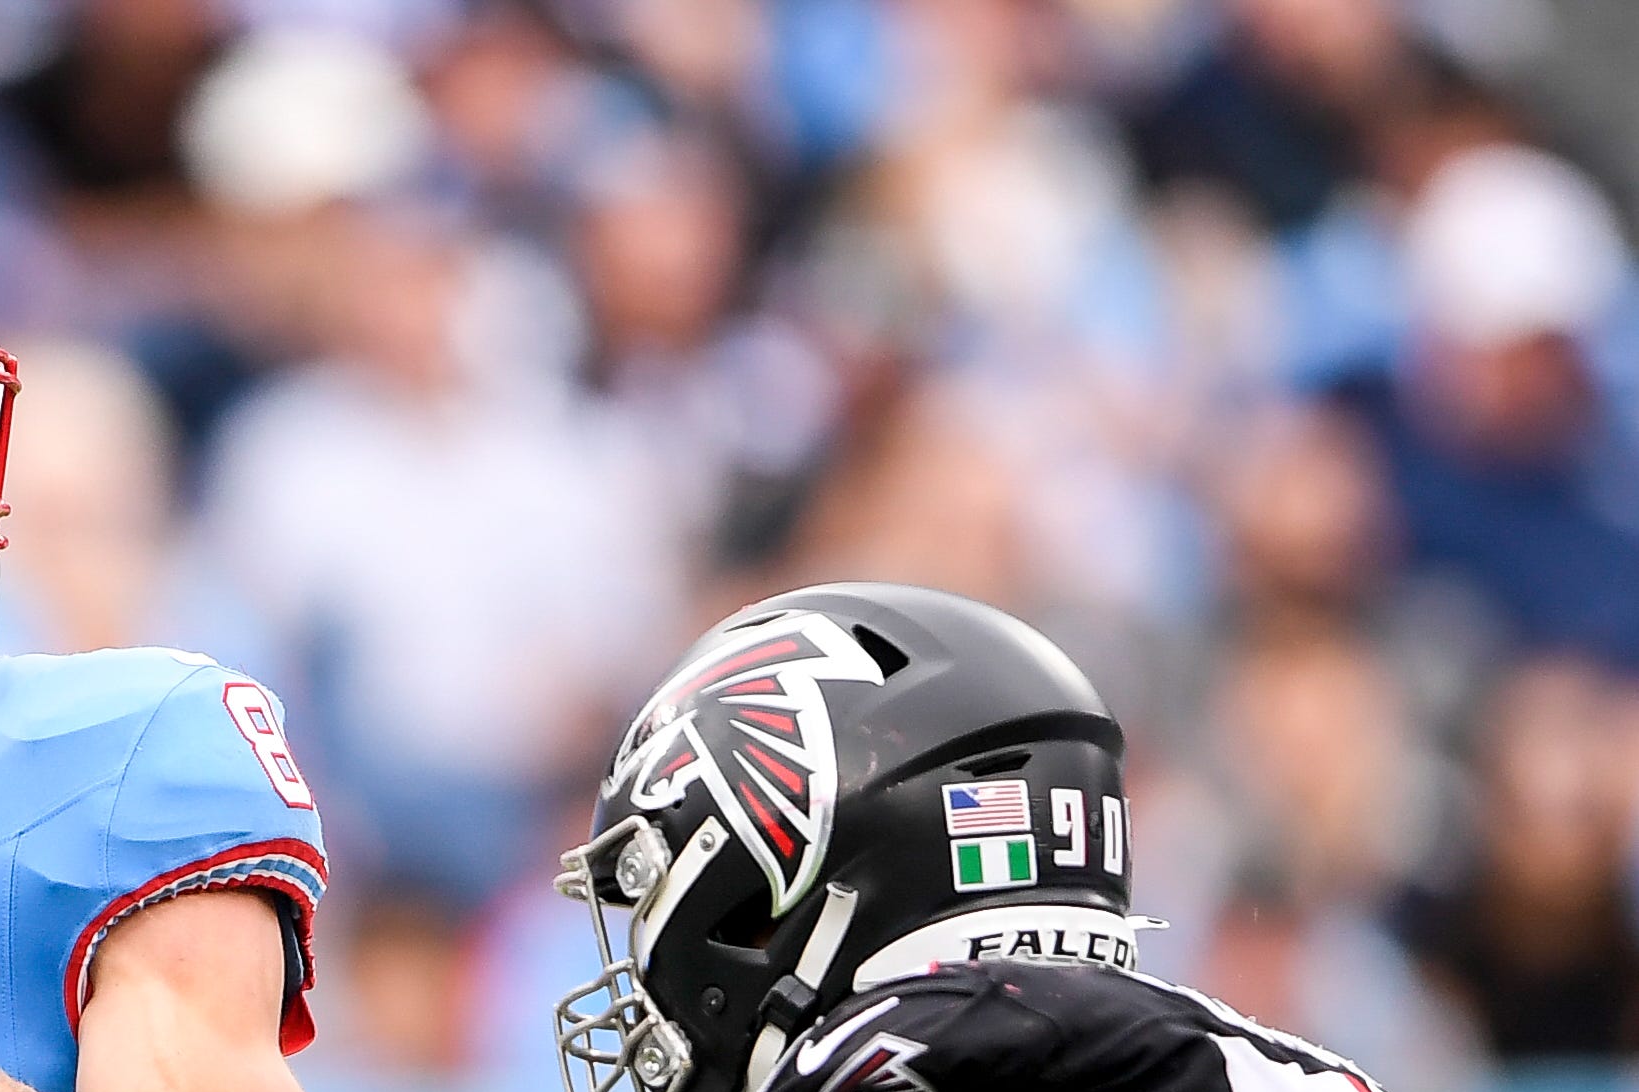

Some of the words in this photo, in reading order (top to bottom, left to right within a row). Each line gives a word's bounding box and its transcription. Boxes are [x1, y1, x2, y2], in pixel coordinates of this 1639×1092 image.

[223, 682, 315, 810] 8
[1049, 787, 1125, 877] 90
[968, 929, 1137, 973] FALCO
